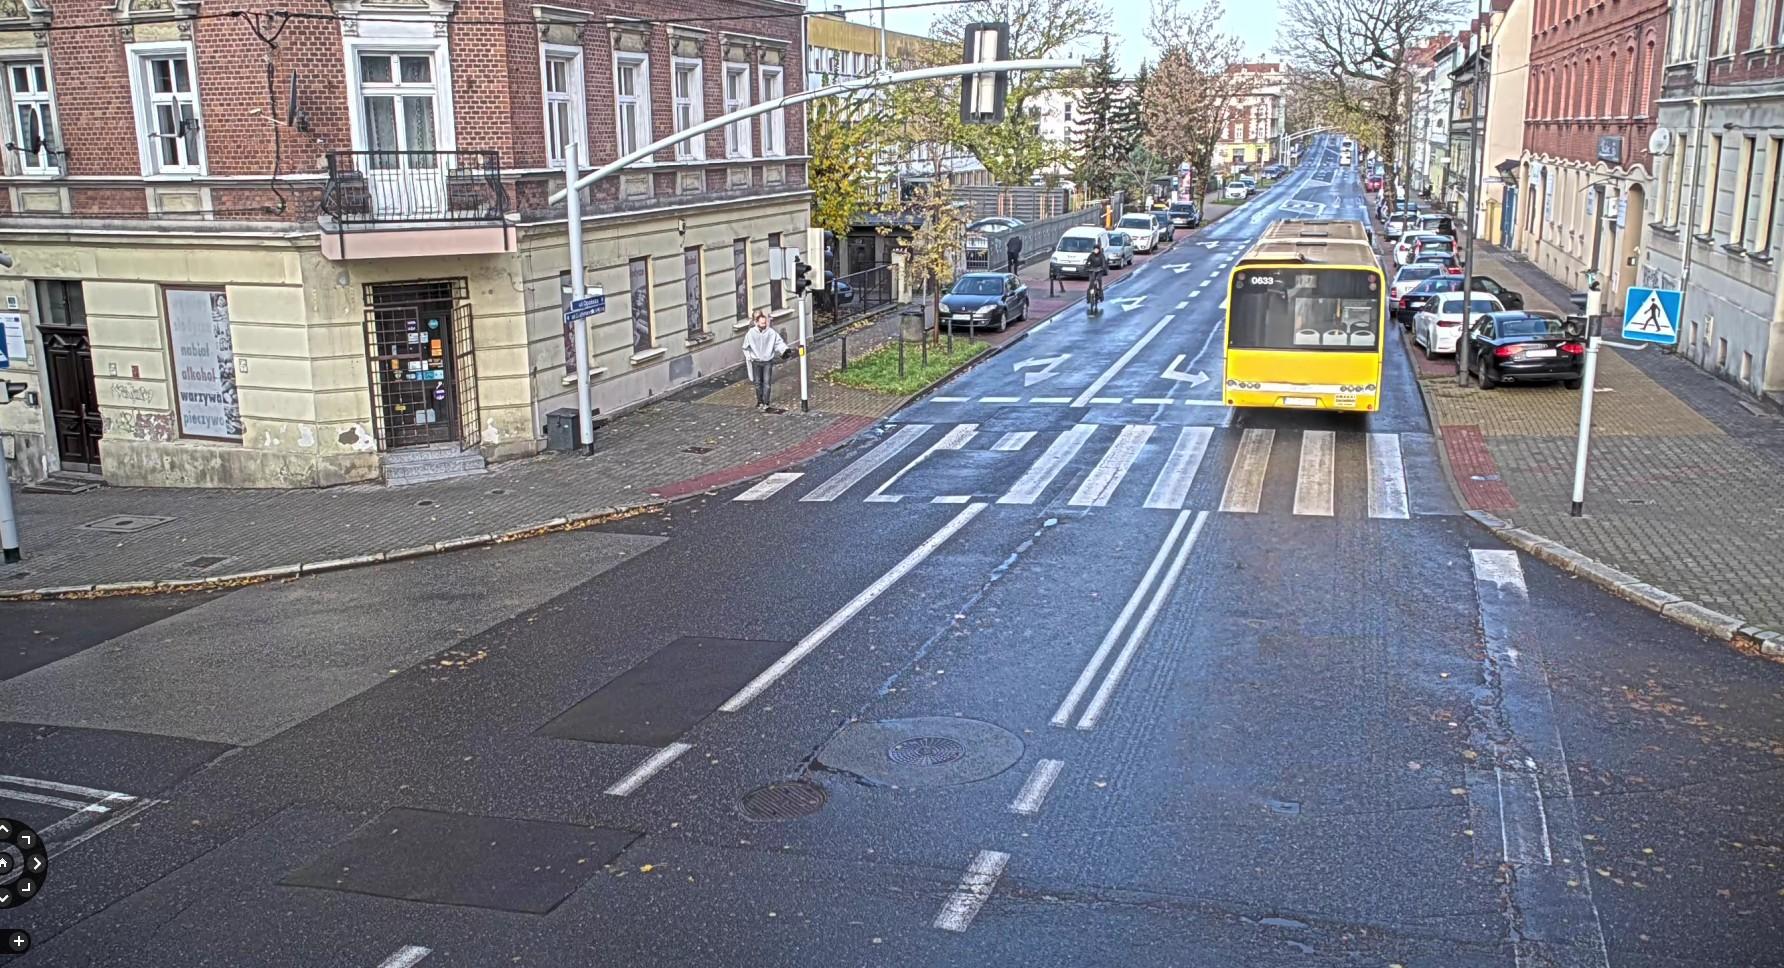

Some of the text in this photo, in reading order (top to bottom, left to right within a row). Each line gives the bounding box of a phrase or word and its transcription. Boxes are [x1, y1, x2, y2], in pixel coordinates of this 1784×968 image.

[1251, 276, 1274, 285] 0633
[181, 366, 216, 382] alkohol
[180, 391, 222, 407] warzywa
[183, 410, 225, 429] pieczywo
